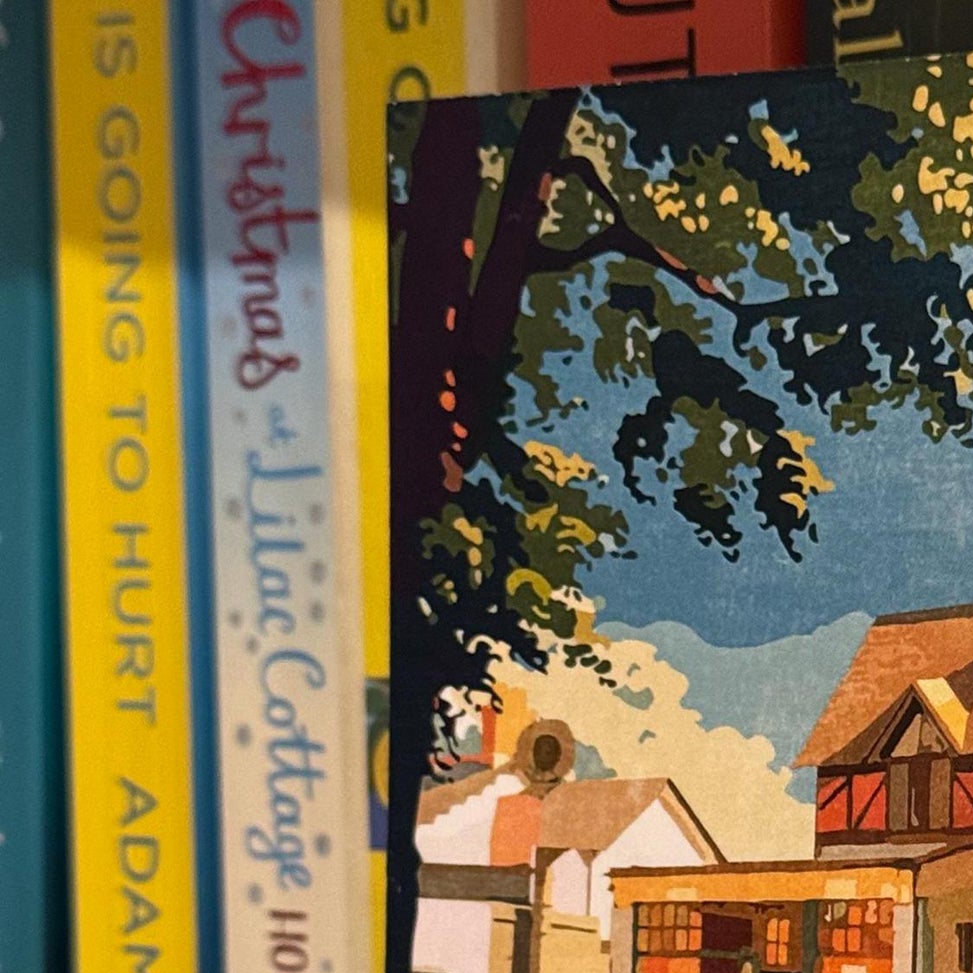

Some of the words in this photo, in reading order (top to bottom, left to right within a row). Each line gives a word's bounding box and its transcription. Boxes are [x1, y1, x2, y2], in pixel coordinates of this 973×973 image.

[95, 12, 138, 79] IS
[98, 106, 146, 363] GOING
[220, 0, 321, 392] Christmas
[107, 395, 150, 493] TO
[247, 449, 323, 638] Lilac
[112, 523, 157, 726] HURT
[244, 649, 326, 890] Cottage
